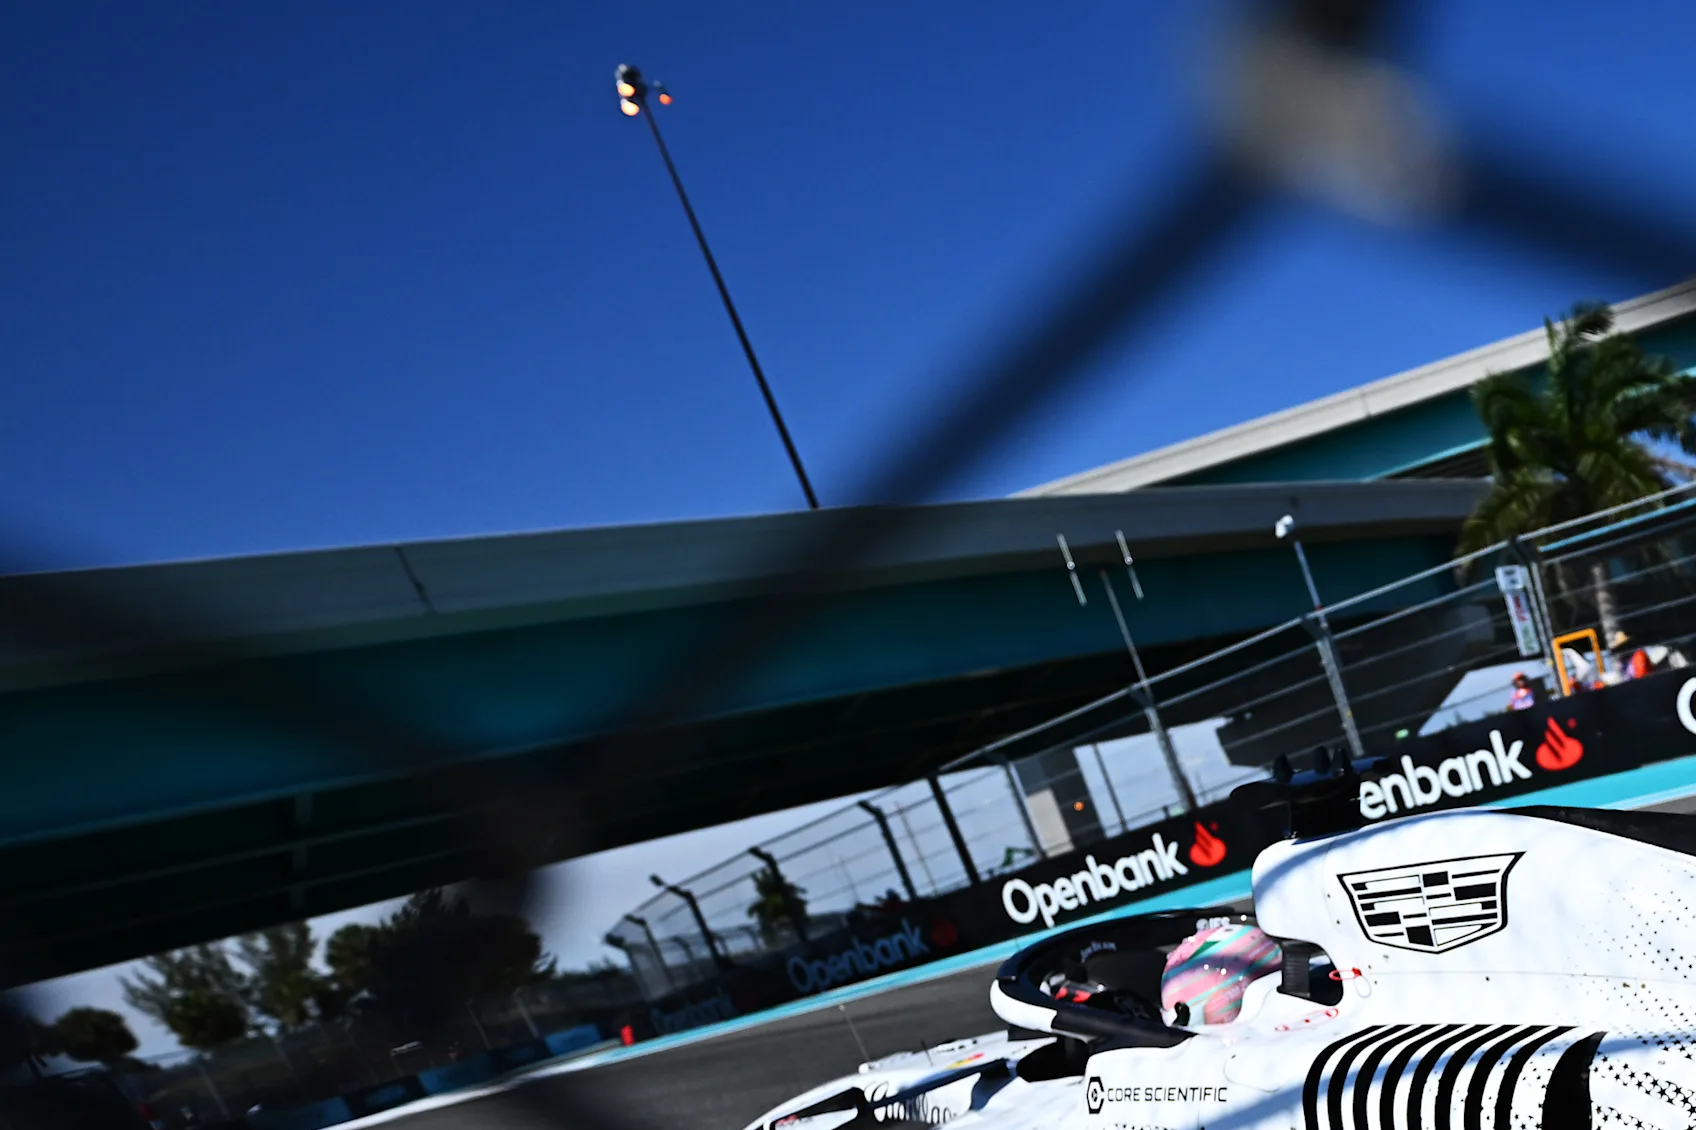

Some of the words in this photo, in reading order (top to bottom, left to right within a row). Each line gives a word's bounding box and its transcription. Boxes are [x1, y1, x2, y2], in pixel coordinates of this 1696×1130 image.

[1359, 730, 1533, 820] enbank
[1002, 833, 1189, 928] Openbank
[786, 919, 931, 993] Openbank
[1107, 1087, 1141, 1102] CORE
[1144, 1087, 1228, 1103] SCIENTIFIC
